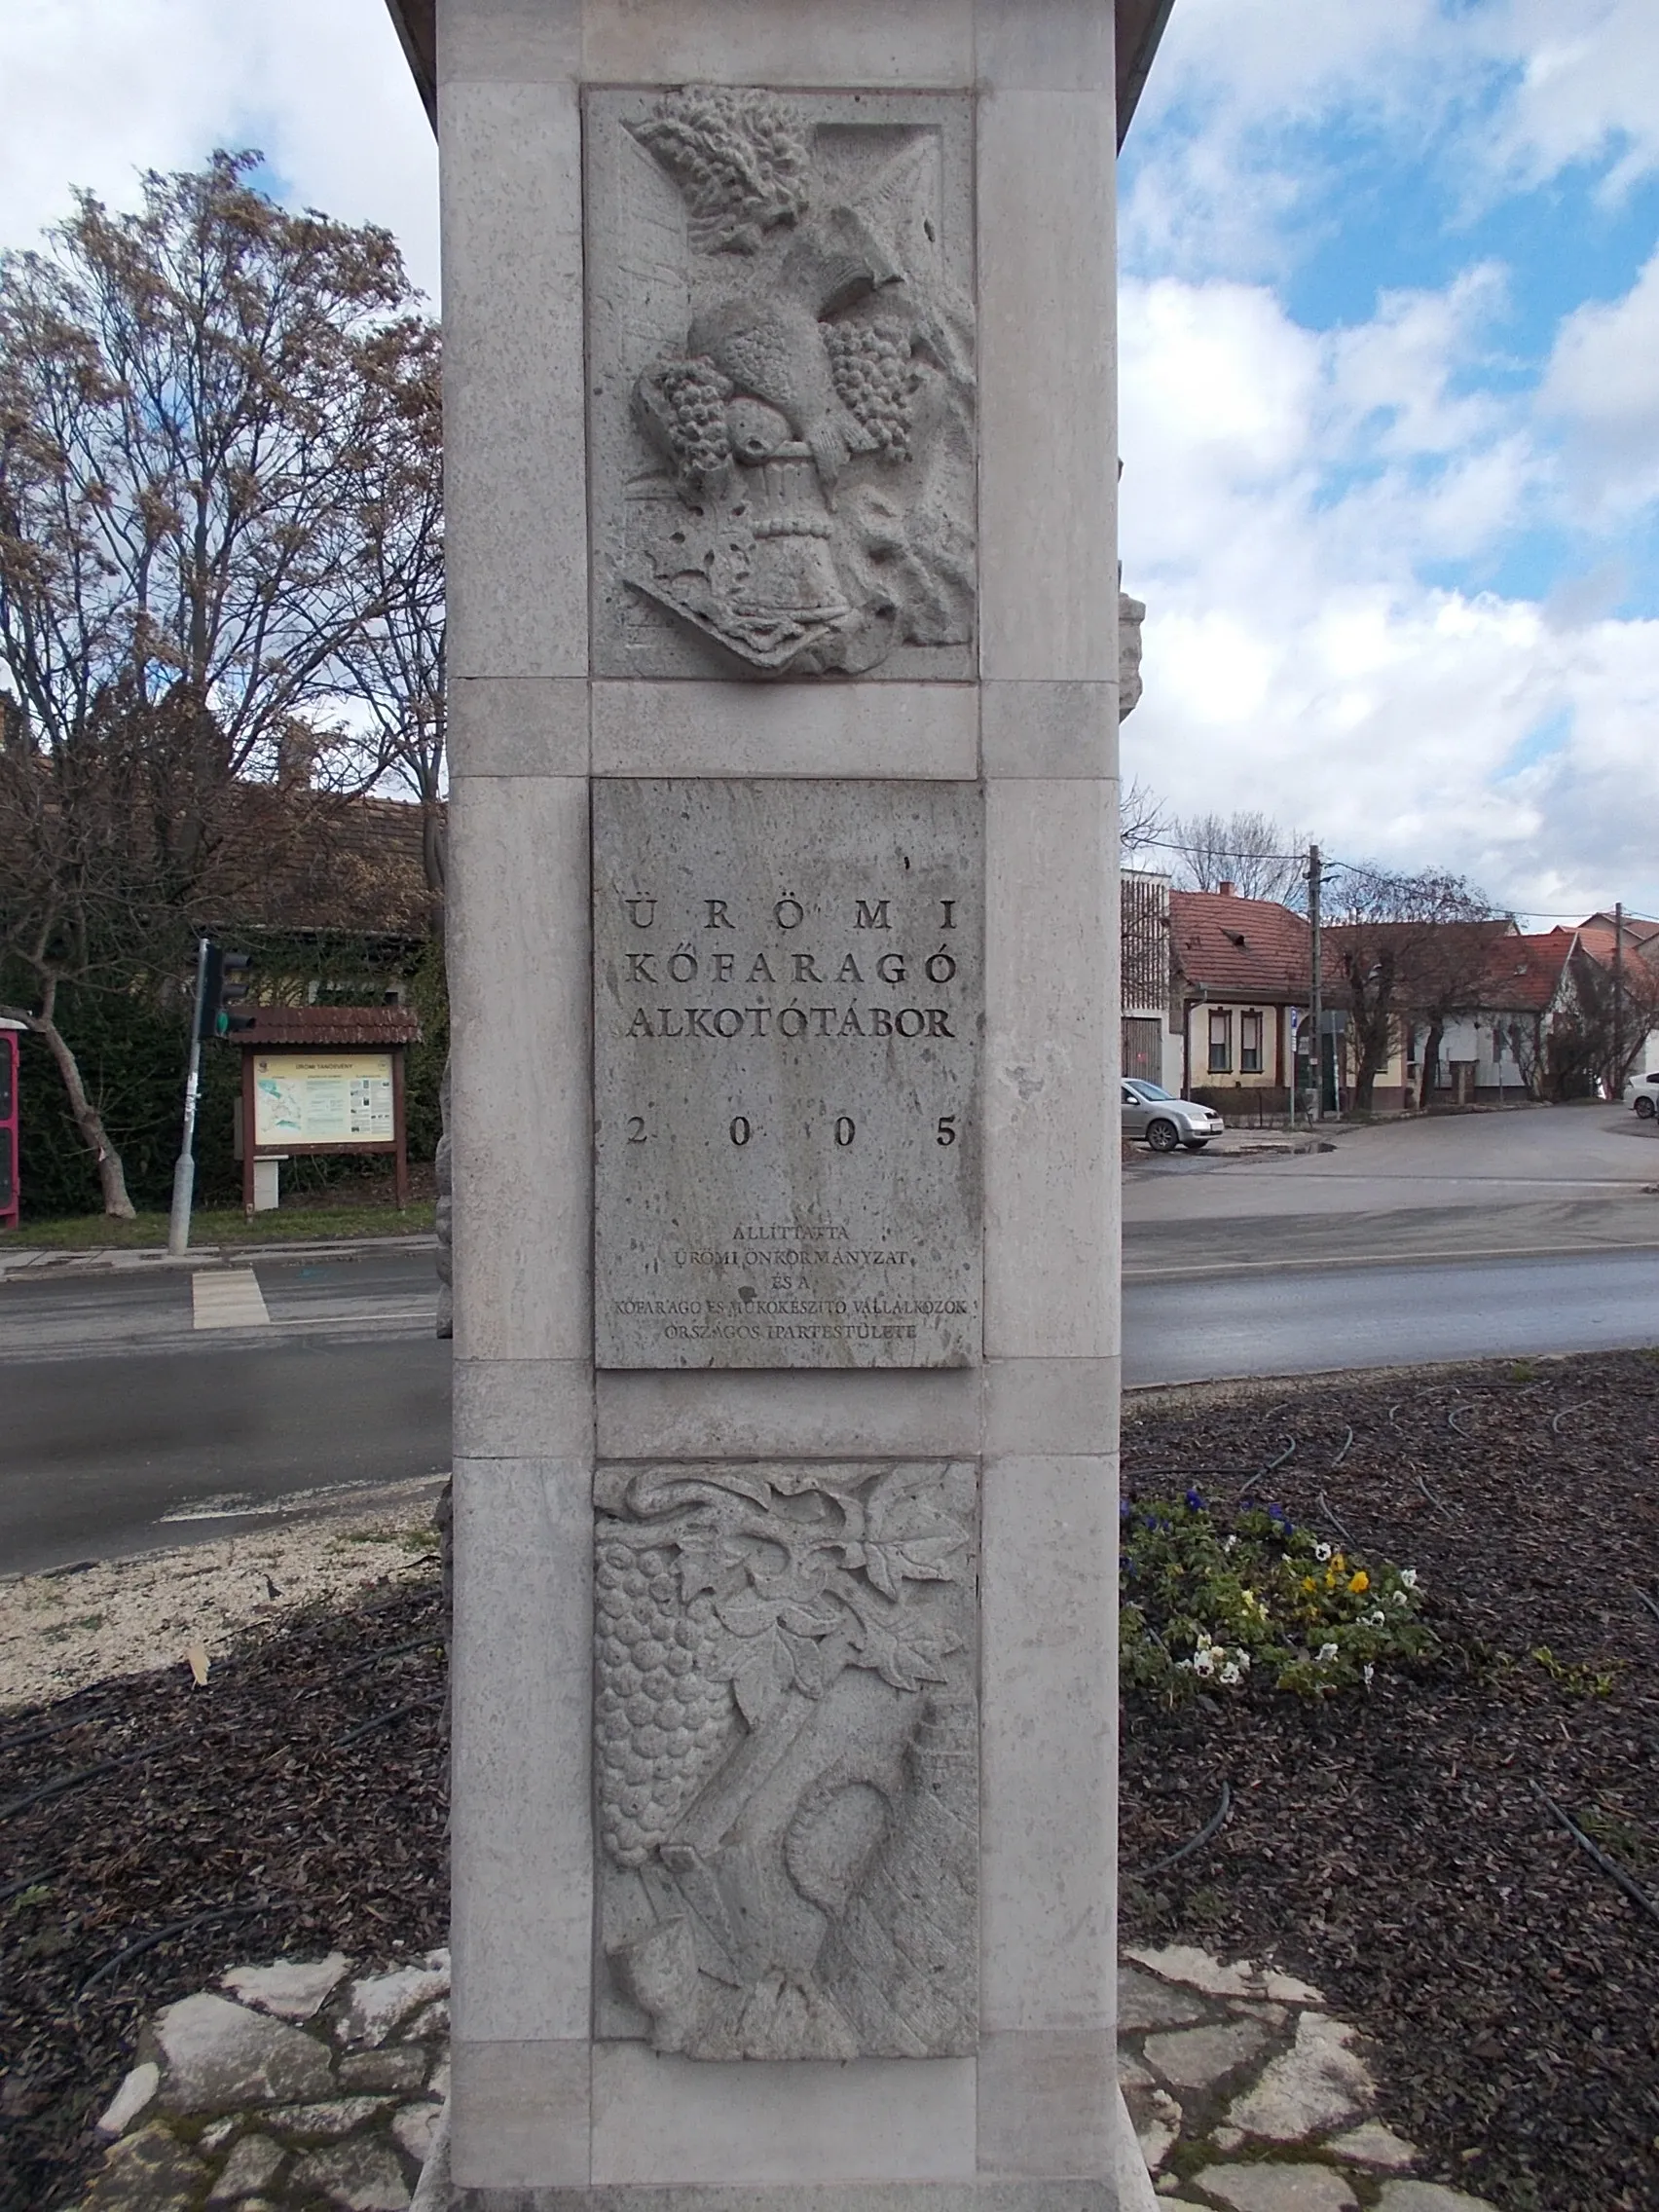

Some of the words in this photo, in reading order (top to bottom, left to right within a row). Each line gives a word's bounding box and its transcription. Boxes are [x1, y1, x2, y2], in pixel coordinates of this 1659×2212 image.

[625, 891, 957, 929] ÜRÖMI
[625, 942, 957, 983] KŐFARAGÓ
[626, 998, 955, 1038] ALKOTÓTÁBOR
[627, 1116, 956, 1147] 2005
[798, 1275, 810, 1290] A
